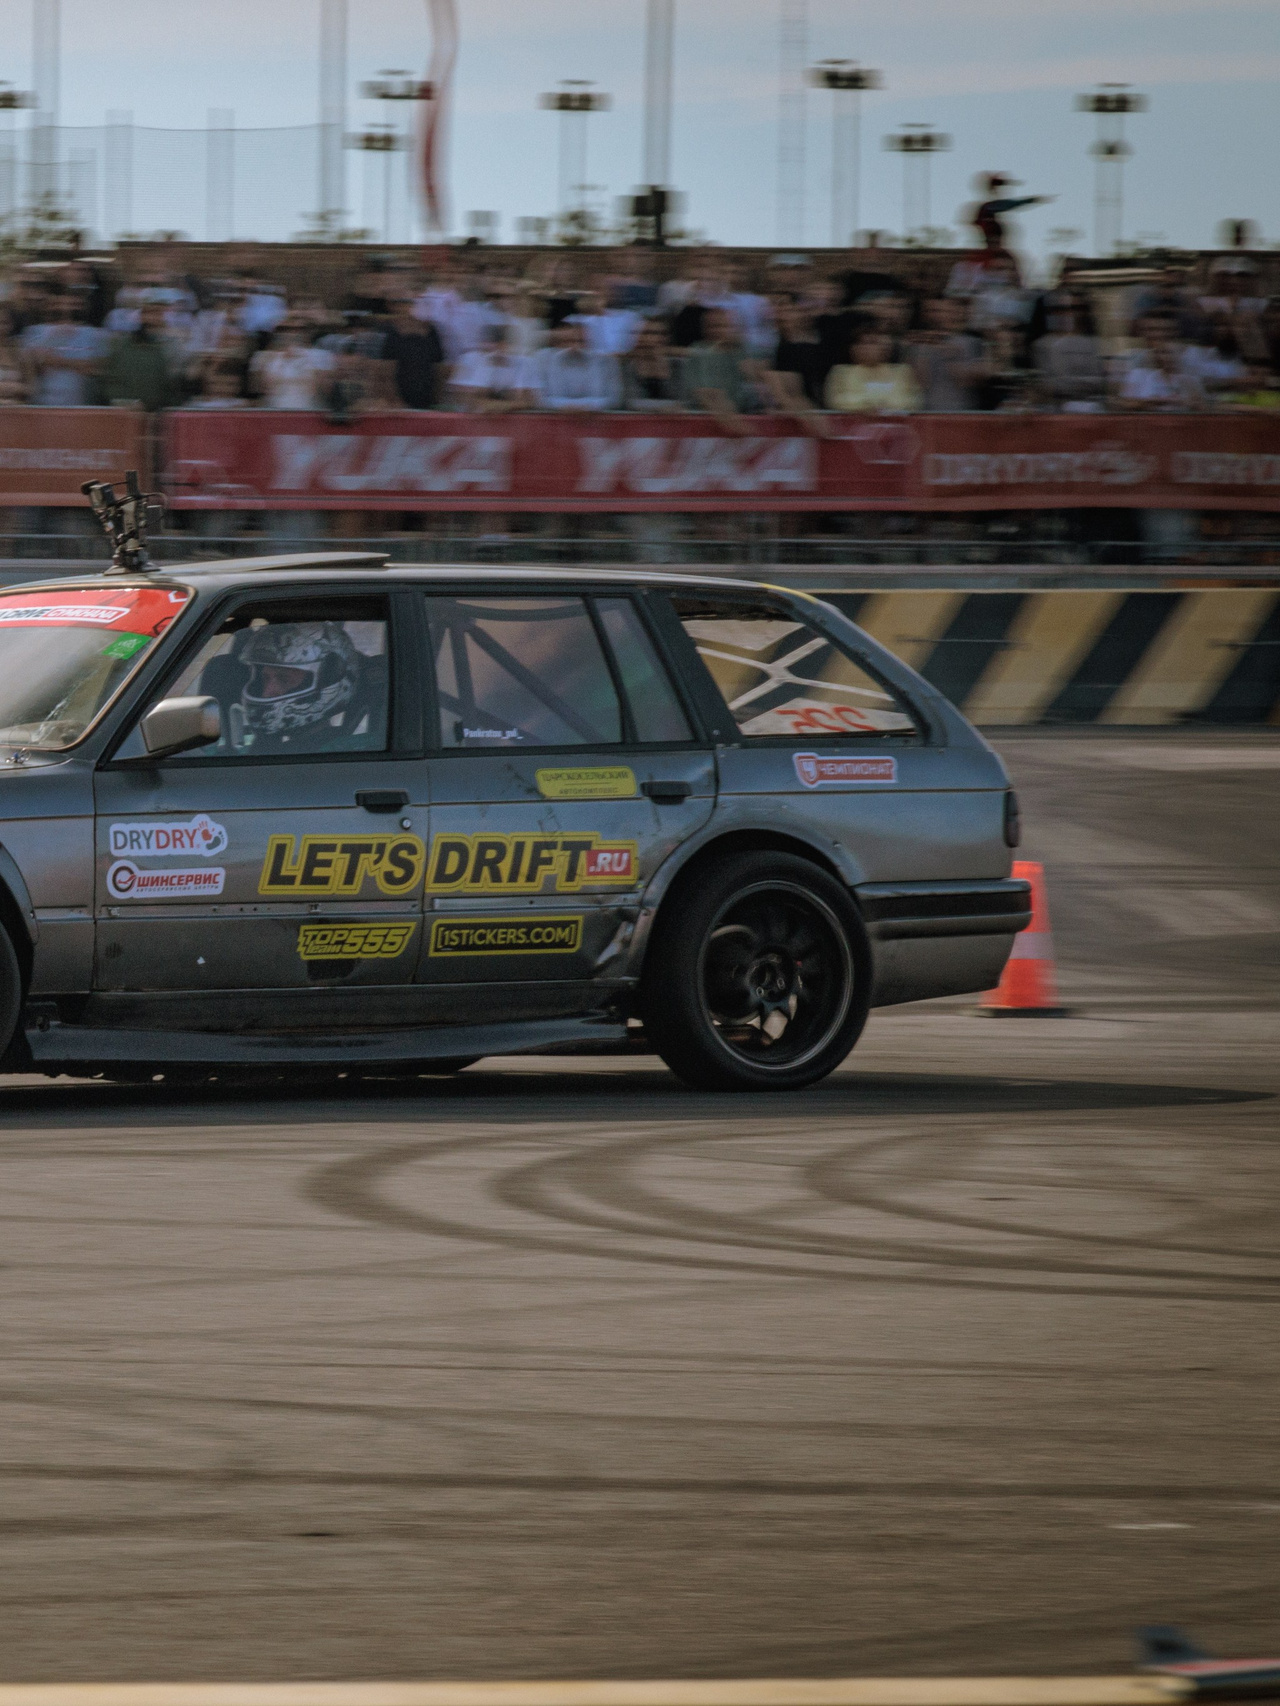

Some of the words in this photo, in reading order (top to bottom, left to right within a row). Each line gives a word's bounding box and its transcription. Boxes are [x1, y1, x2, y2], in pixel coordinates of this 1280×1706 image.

[113, 828, 198, 850] DRYDRY
[267, 842, 418, 886] LET'S
[137, 873, 220, 888] ШИНСЕРВИС
